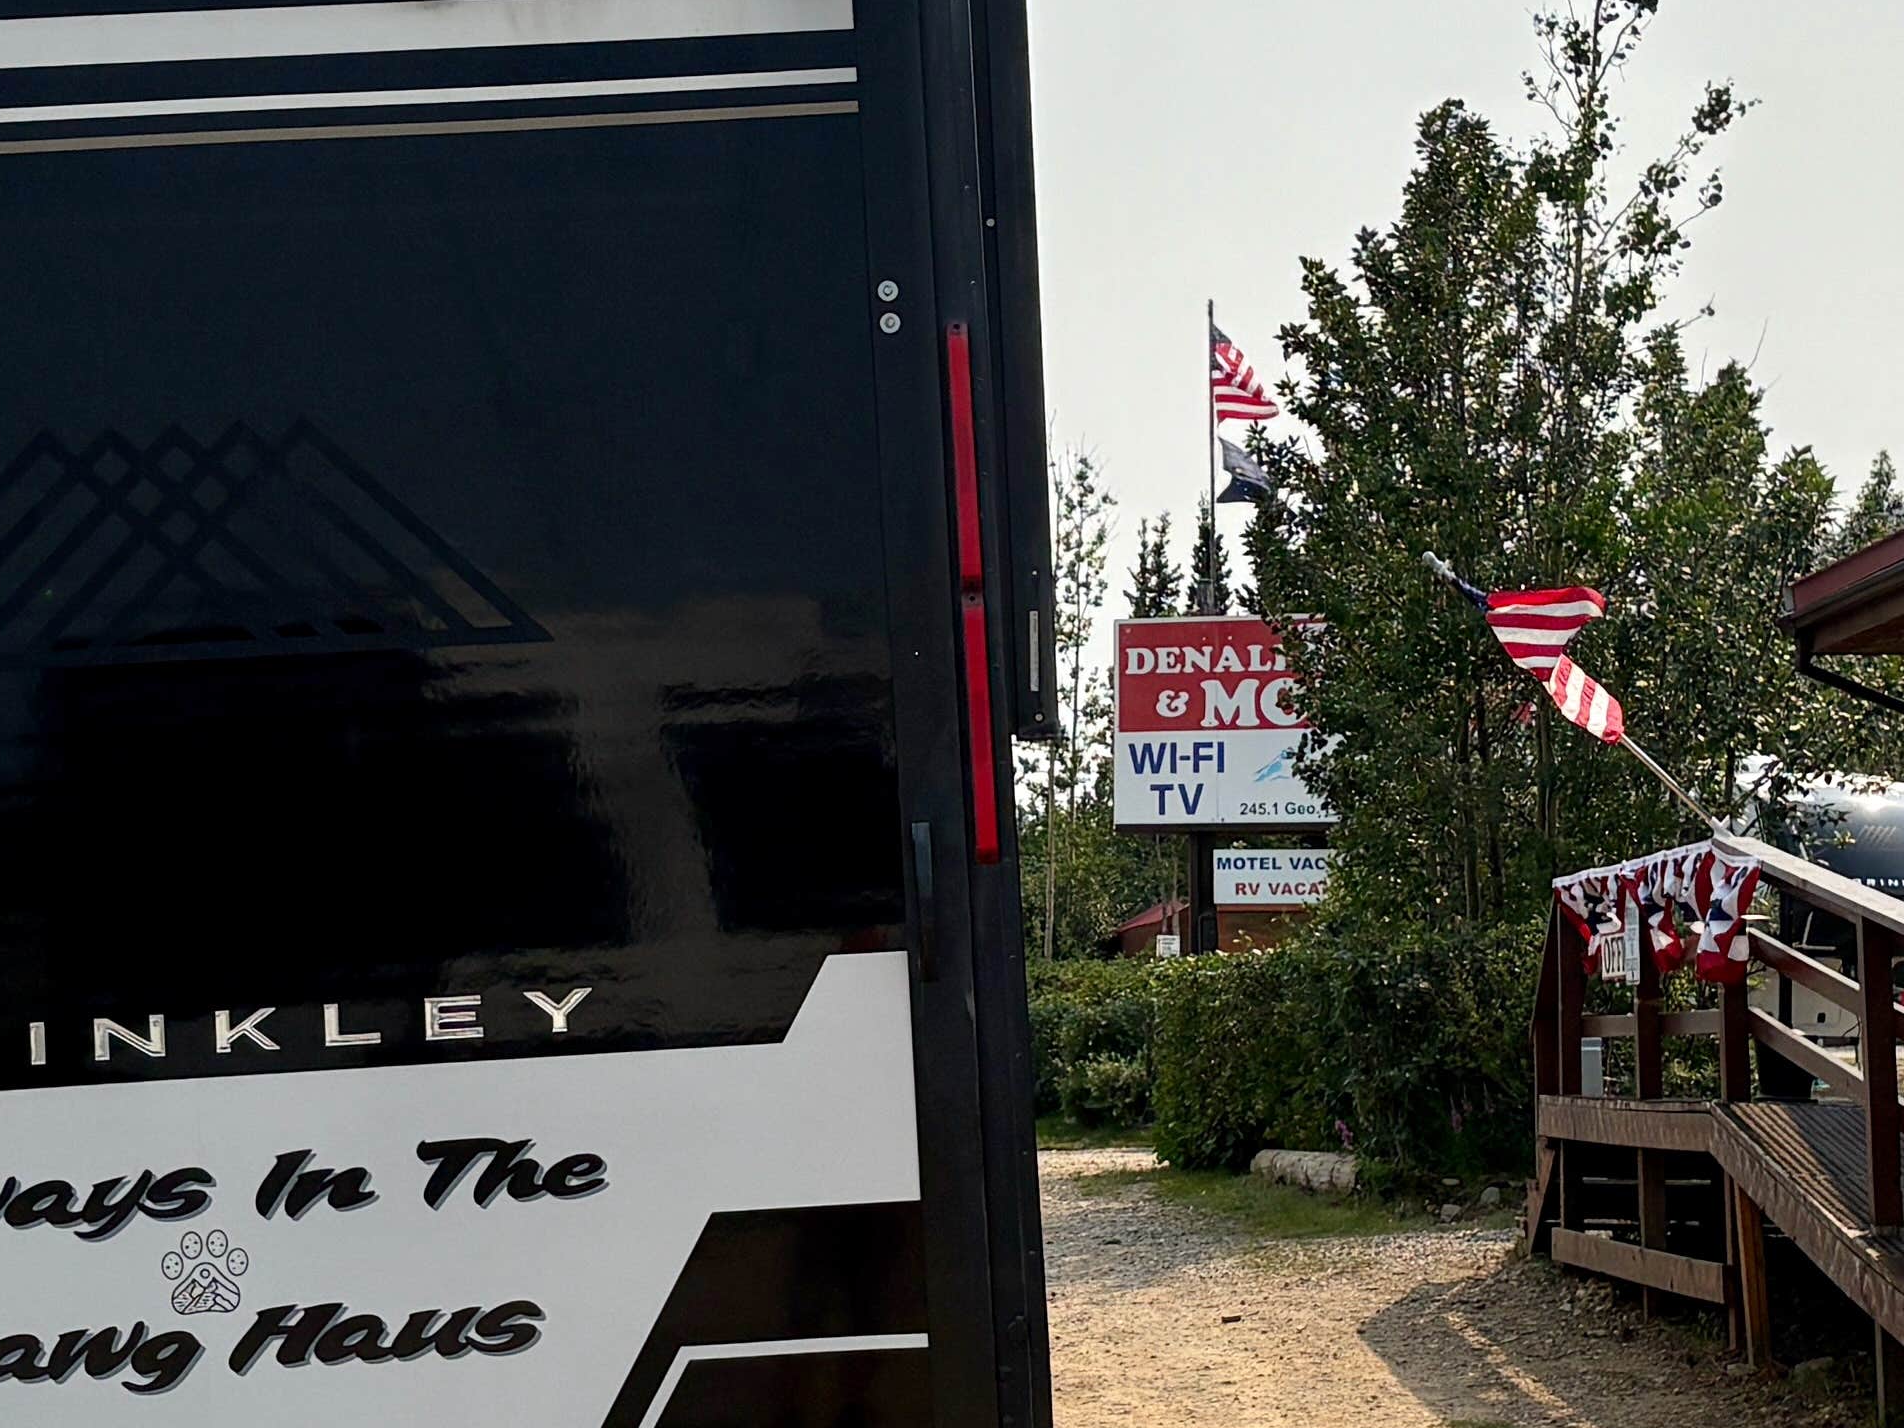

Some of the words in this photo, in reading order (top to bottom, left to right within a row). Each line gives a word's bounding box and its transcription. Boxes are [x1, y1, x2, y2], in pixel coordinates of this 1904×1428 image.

[1156, 689, 1190, 718] &
[1128, 741, 1225, 775] WI-FI
[1149, 783, 1204, 816] TV
[1239, 801, 1279, 816] 245.1
[1216, 857, 1282, 870] MOTEL
[1235, 882, 1260, 896] RV
[254, 1148, 378, 1221] In
[416, 1137, 610, 1209] The
[228, 1299, 546, 1377] Haus
